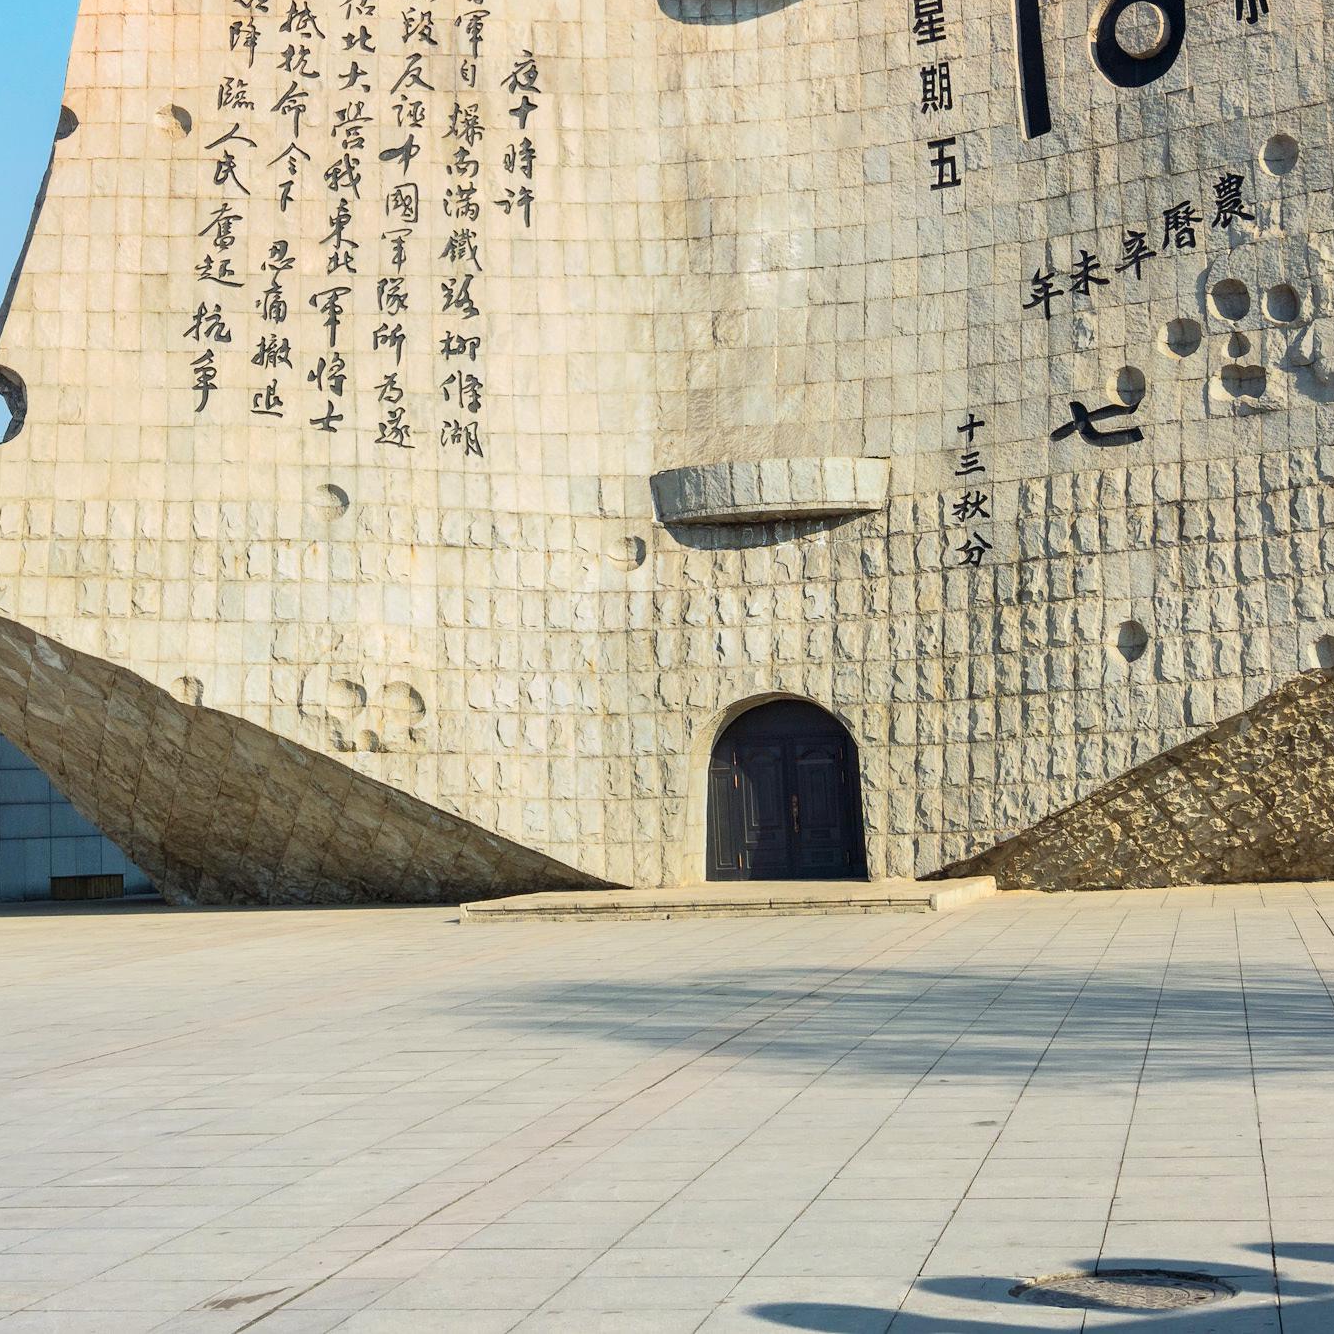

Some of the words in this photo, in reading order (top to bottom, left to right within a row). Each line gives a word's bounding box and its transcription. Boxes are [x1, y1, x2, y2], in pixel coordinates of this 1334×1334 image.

[493, 48, 541, 228] 夜十時許
[951, 413, 993, 567] 十三秋分
[1049, 400, 1145, 447] 七
